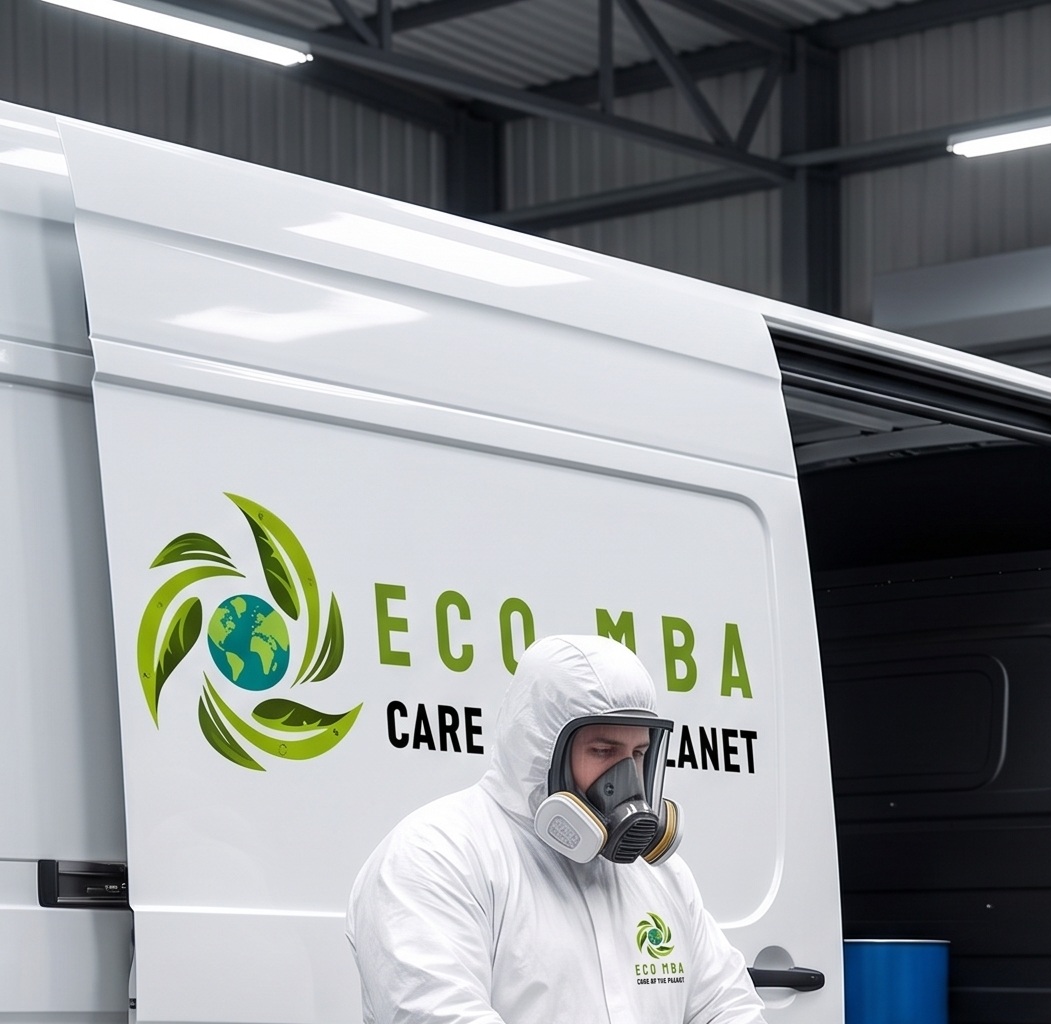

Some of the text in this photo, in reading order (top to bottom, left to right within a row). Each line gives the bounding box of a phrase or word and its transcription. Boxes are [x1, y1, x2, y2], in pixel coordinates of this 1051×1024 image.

[375, 583, 536, 676] ECO
[387, 700, 757, 774] CARE ANET
[635, 963, 684, 976] ECO MBA
